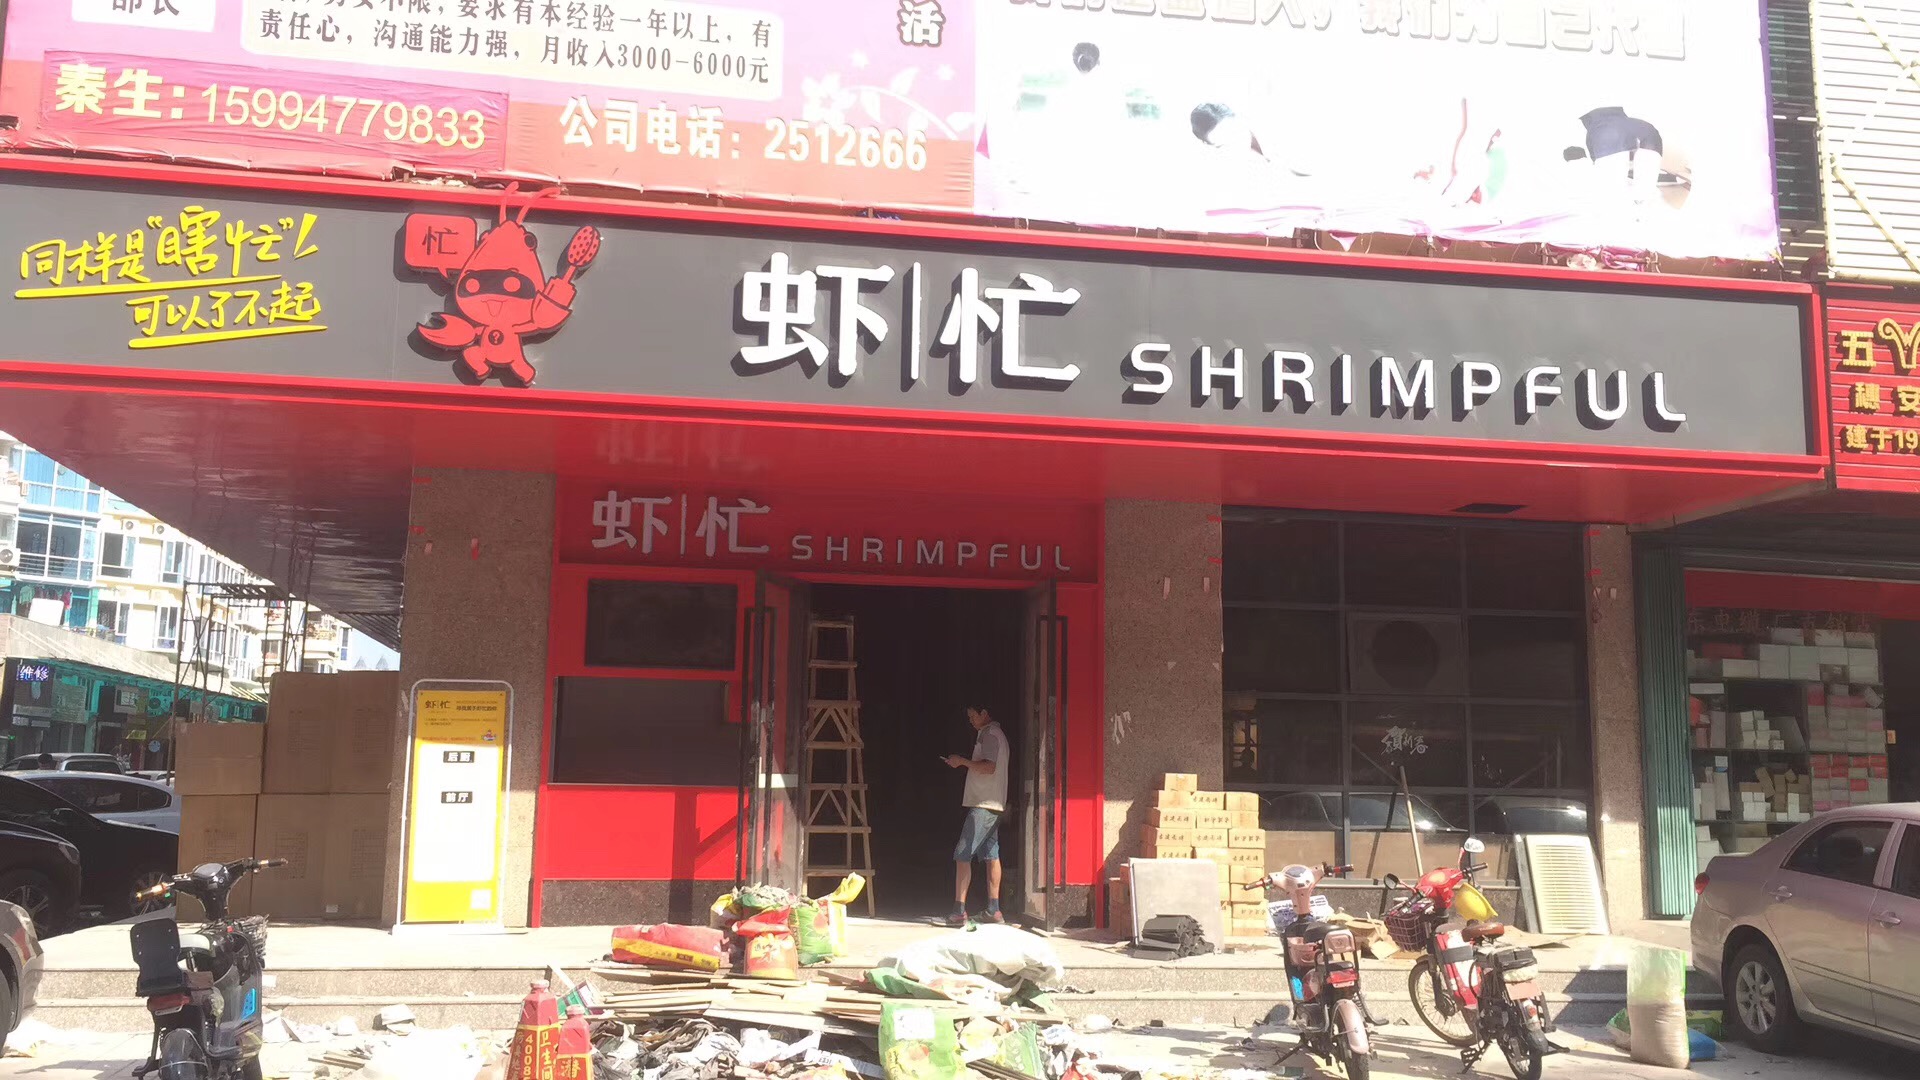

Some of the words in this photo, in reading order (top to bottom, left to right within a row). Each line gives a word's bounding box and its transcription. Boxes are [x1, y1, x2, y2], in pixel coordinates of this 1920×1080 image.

[558, 95, 928, 172] 公司电话:2512666
[420, 227, 459, 257] 忙
[126, 281, 321, 335] 可以了不起
[1129, 341, 1688, 422] SHRIMPFUL
[790, 534, 1072, 572] SHRIMPFUL
